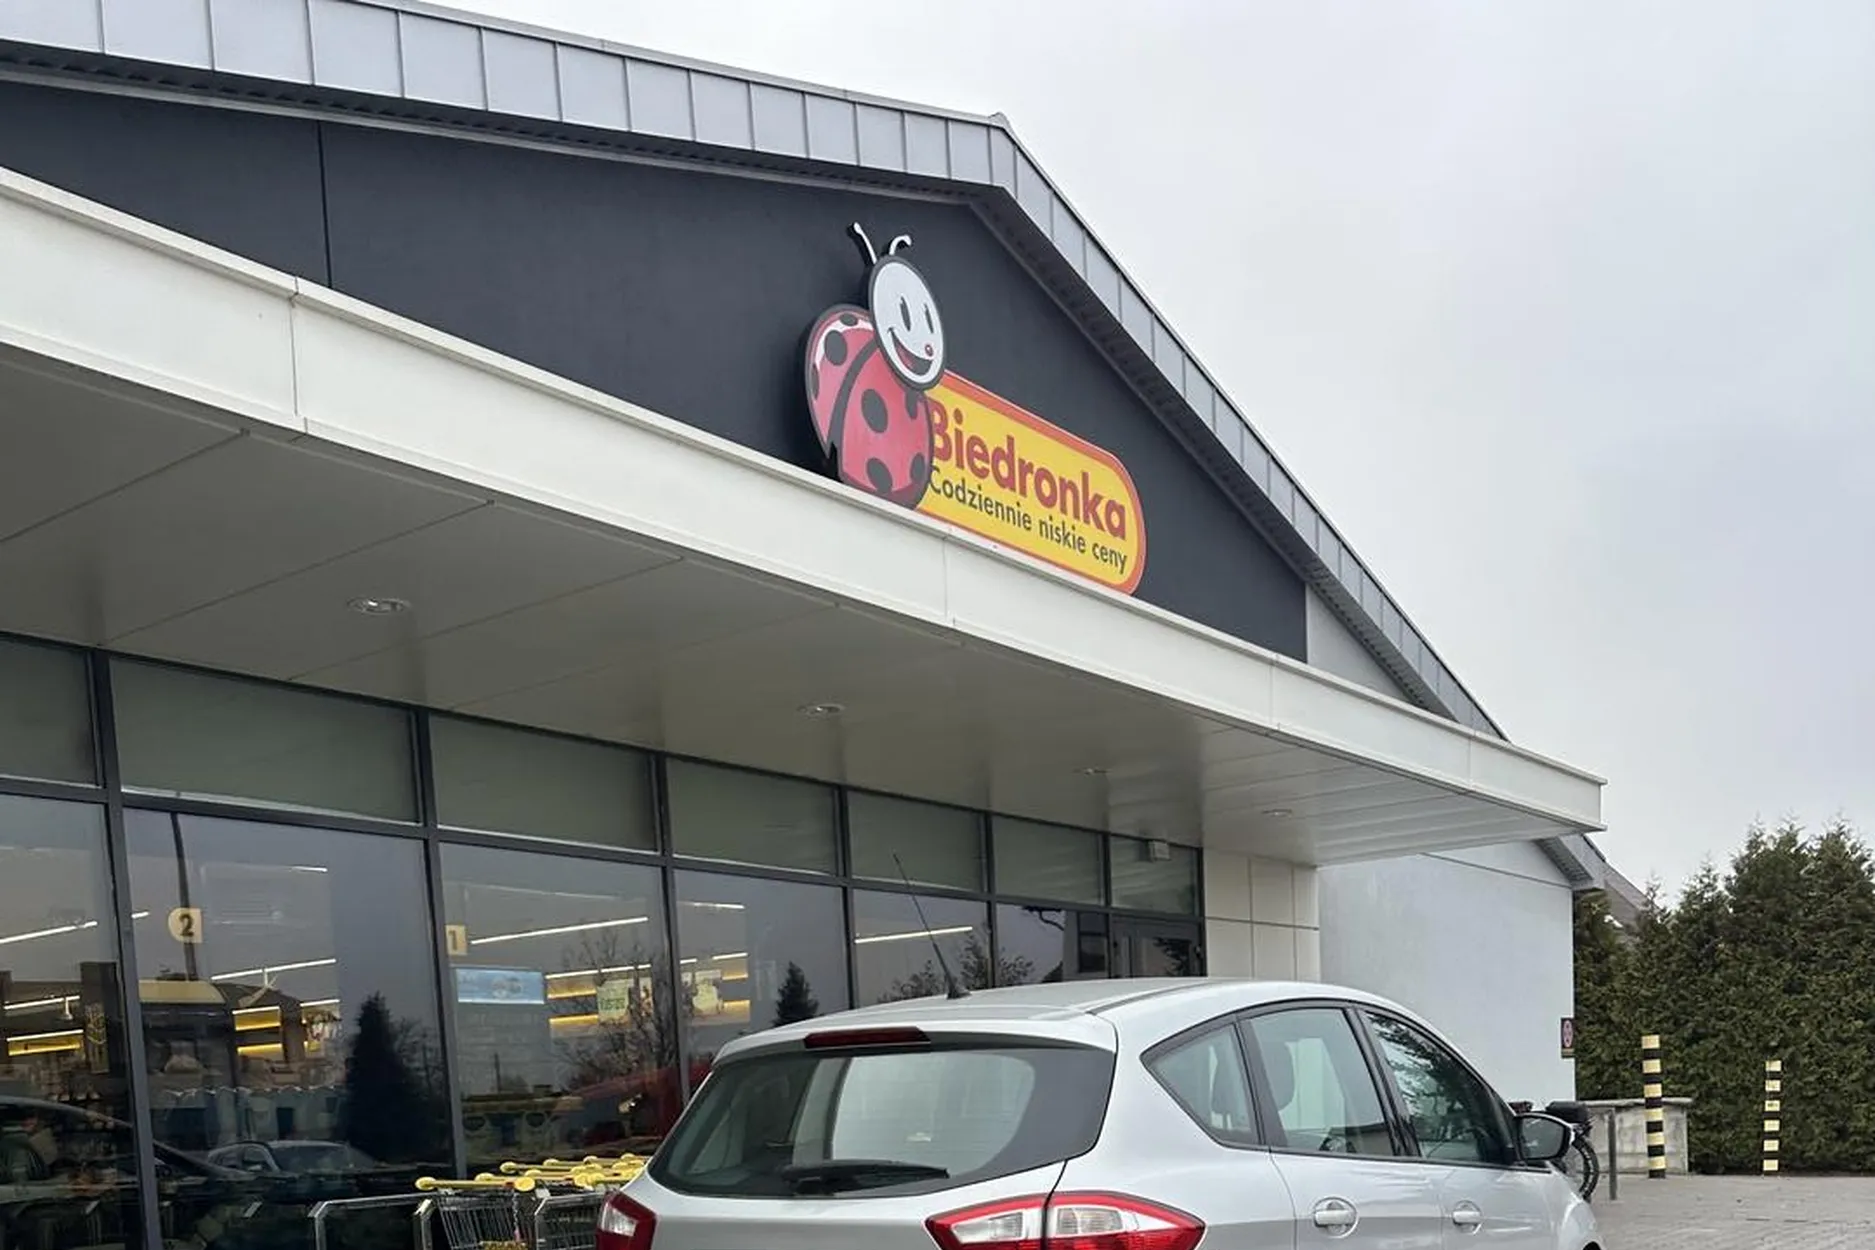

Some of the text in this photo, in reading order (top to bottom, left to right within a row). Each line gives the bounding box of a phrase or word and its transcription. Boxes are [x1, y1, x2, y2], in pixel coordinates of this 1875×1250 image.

[927, 396, 1126, 540] Biedronka
[930, 464, 1127, 575] Codziennie niskie ceny
[179, 913, 194, 937] 2
[448, 930, 458, 951] 1
